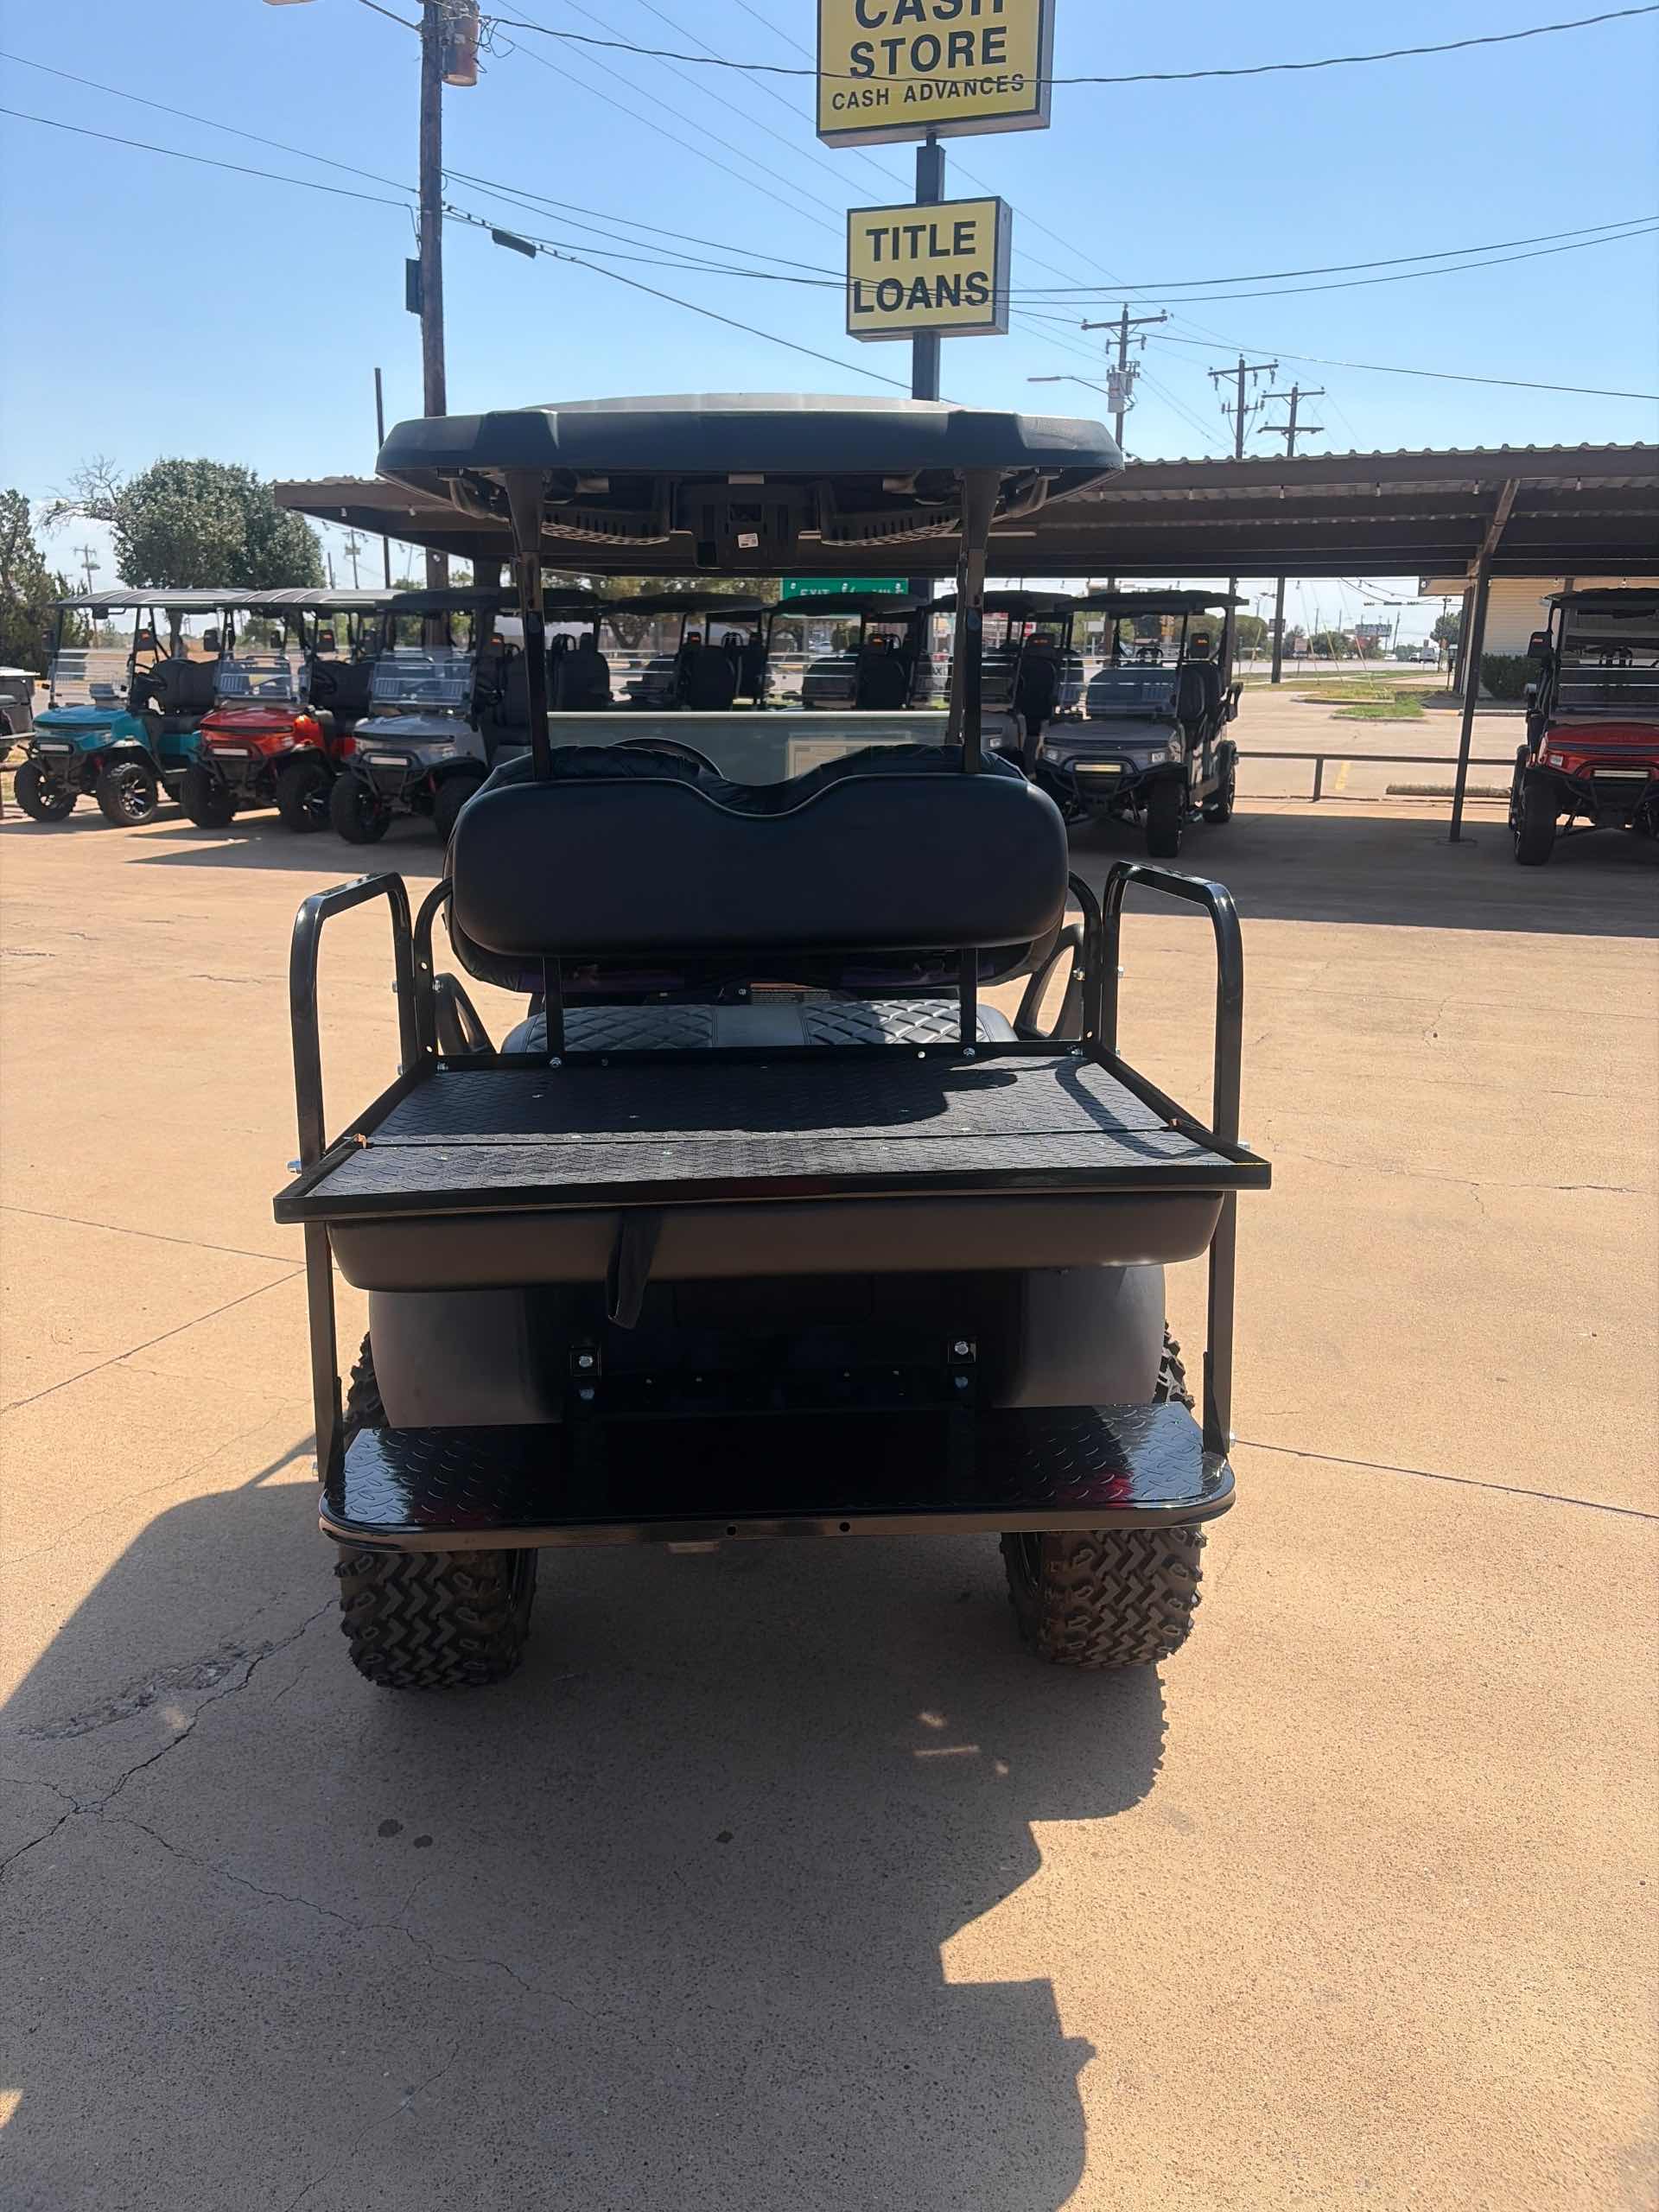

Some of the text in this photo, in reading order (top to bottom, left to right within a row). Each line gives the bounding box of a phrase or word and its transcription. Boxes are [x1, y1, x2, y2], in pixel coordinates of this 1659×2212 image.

[849, 26, 1007, 79] STORE
[832, 73, 1025, 111] CASH ADVANCES
[866, 220, 976, 262] TITLE
[854, 270, 989, 313] LOANS
